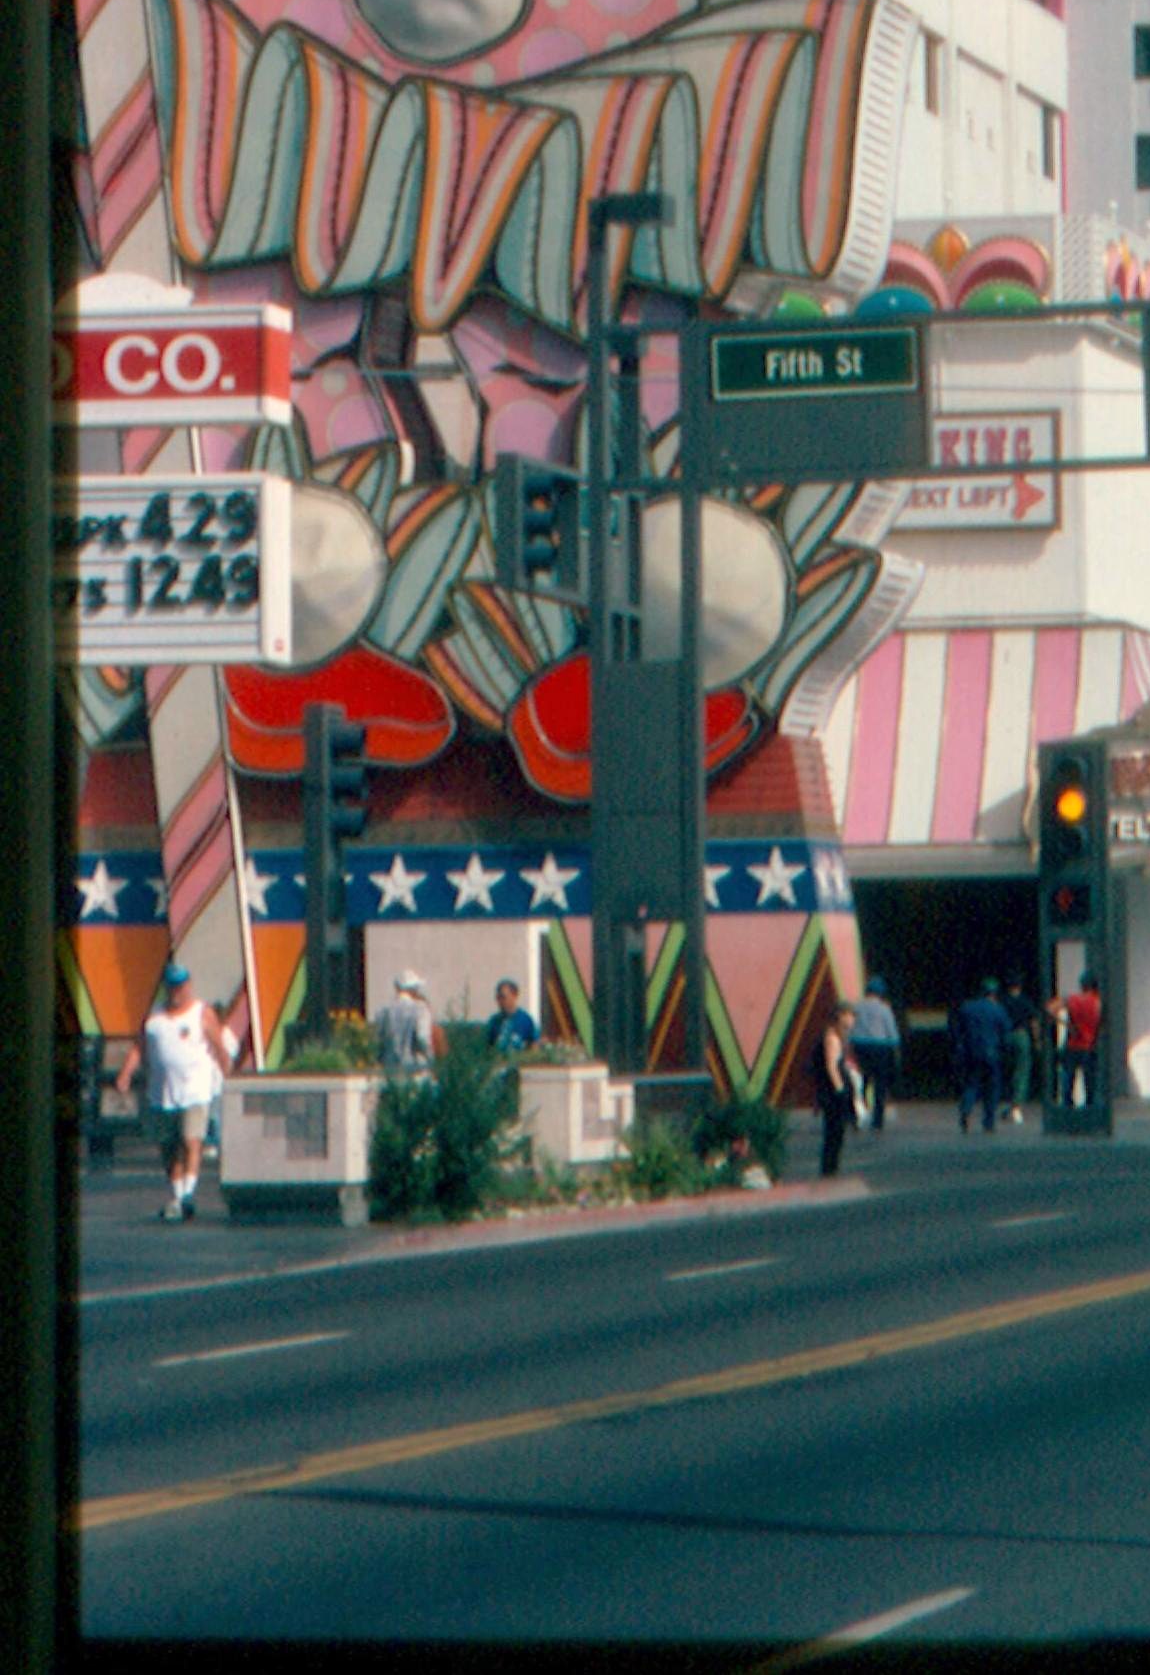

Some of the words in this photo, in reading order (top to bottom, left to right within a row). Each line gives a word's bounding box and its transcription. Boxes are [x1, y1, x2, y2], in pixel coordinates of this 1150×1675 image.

[103, 334, 236, 395] CO.
[766, 347, 824, 380] Fifth
[835, 345, 863, 376] St
[957, 484, 1010, 509] LEFT
